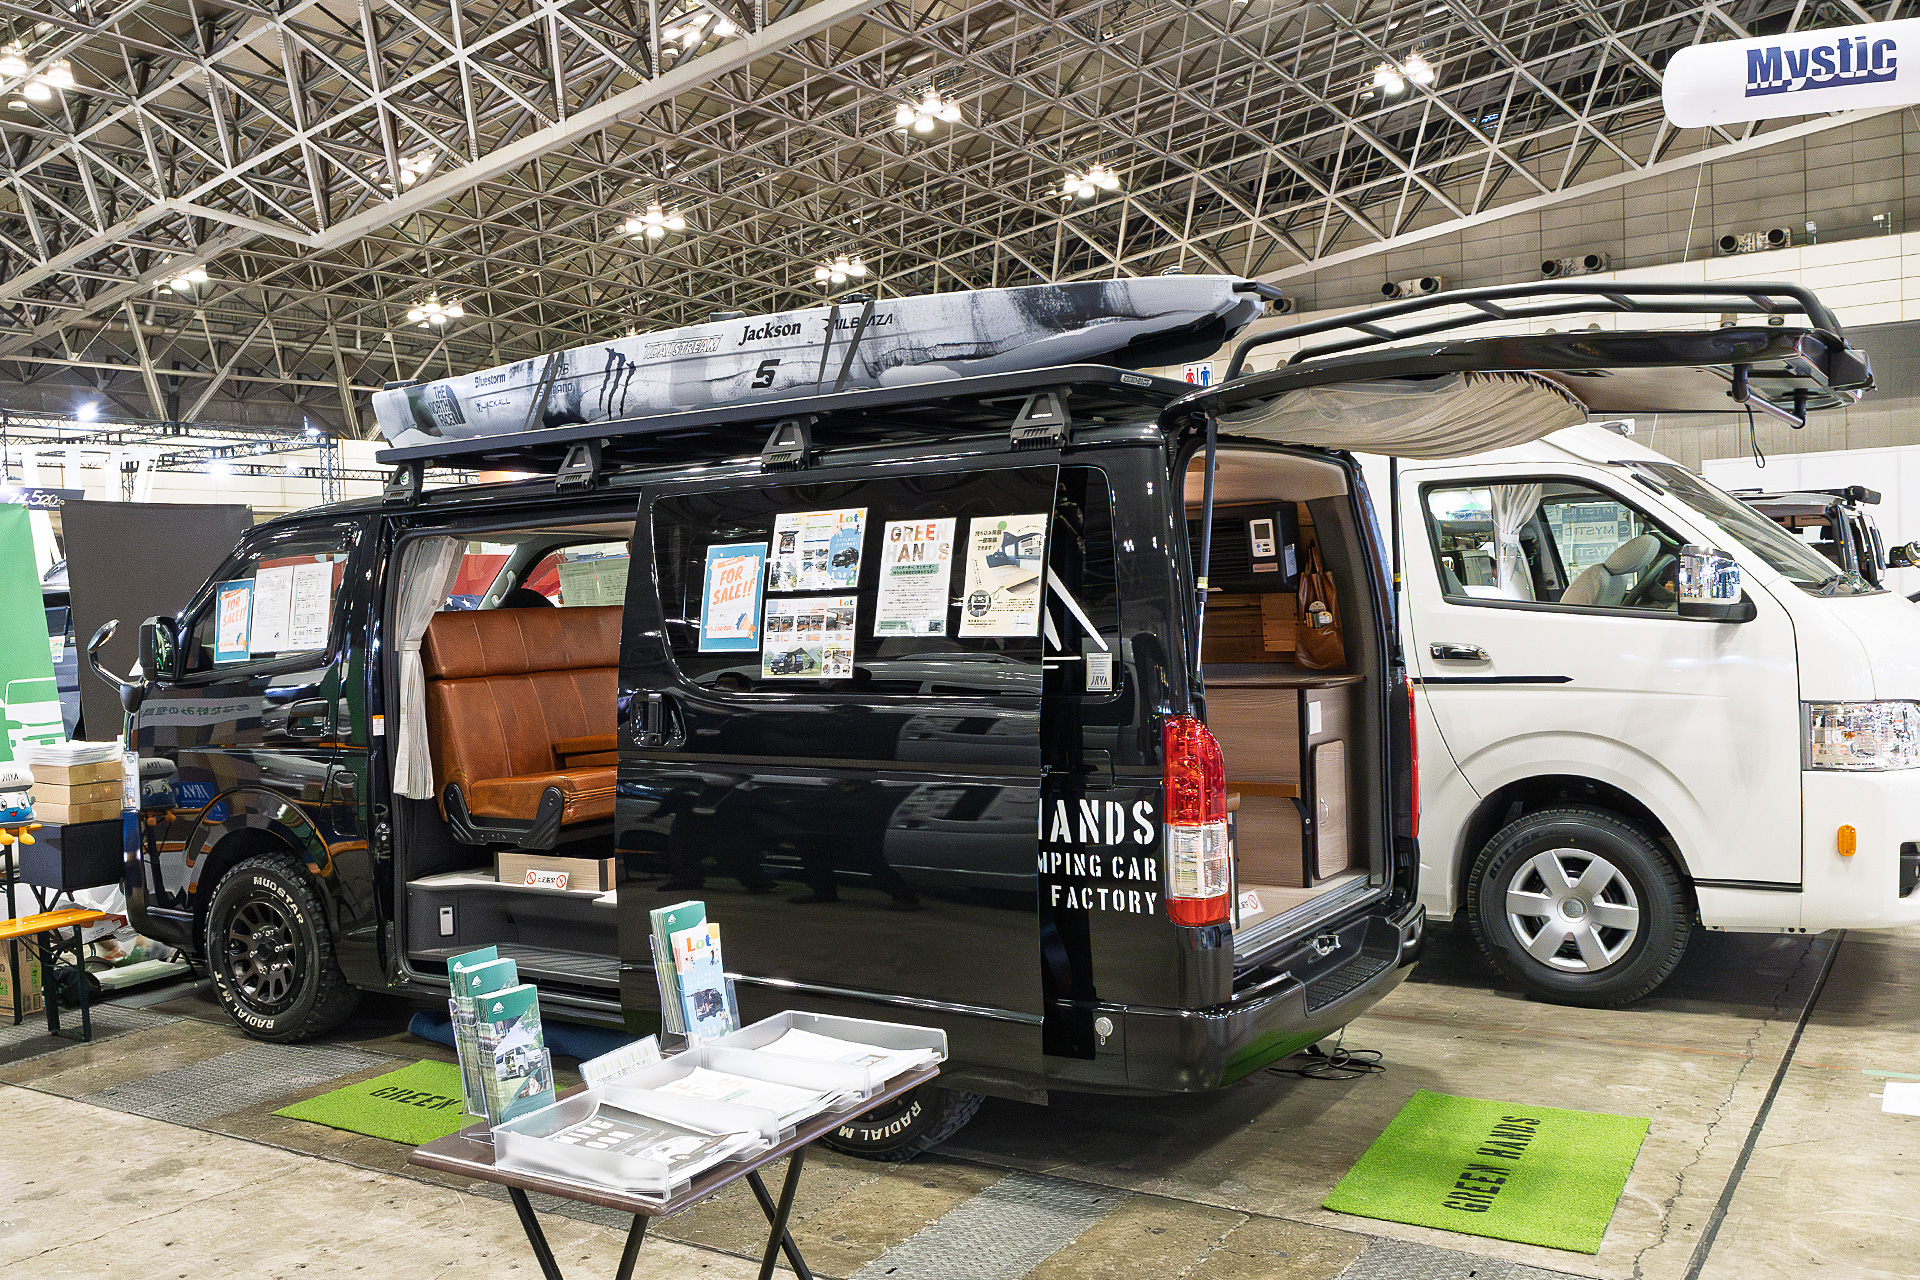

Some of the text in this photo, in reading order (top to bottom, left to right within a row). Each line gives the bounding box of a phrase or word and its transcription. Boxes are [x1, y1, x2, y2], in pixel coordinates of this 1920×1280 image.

[1745, 36, 1898, 97] Mystic
[738, 322, 802, 346] Jackson
[474, 373, 506, 389] Bluestorm
[433, 385, 447, 400] THE
[428, 399, 451, 415] NORTH
[839, 513, 859, 524] Lot
[890, 523, 948, 543] GREEN
[885, 542, 950, 564] HANDS
[719, 565, 744, 586] FOR
[712, 578, 755, 606] SALE!!
[839, 598, 854, 607] Lot
[226, 596, 241, 612] FOR
[222, 605, 248, 628] SALE!!
[1090, 675, 1108, 686] JRVA
[1112, 856, 1157, 882] CAR
[253, 876, 304, 924] MUDSTAR
[1051, 884, 1158, 915] FACTORY
[686, 933, 712, 953] Lot
[233, 1002, 275, 1029] RADIAL
[369, 1086, 462, 1111] GREEN
[860, 1100, 922, 1141] RADIAL
[1441, 1115, 1541, 1213] GREEN HANDS
